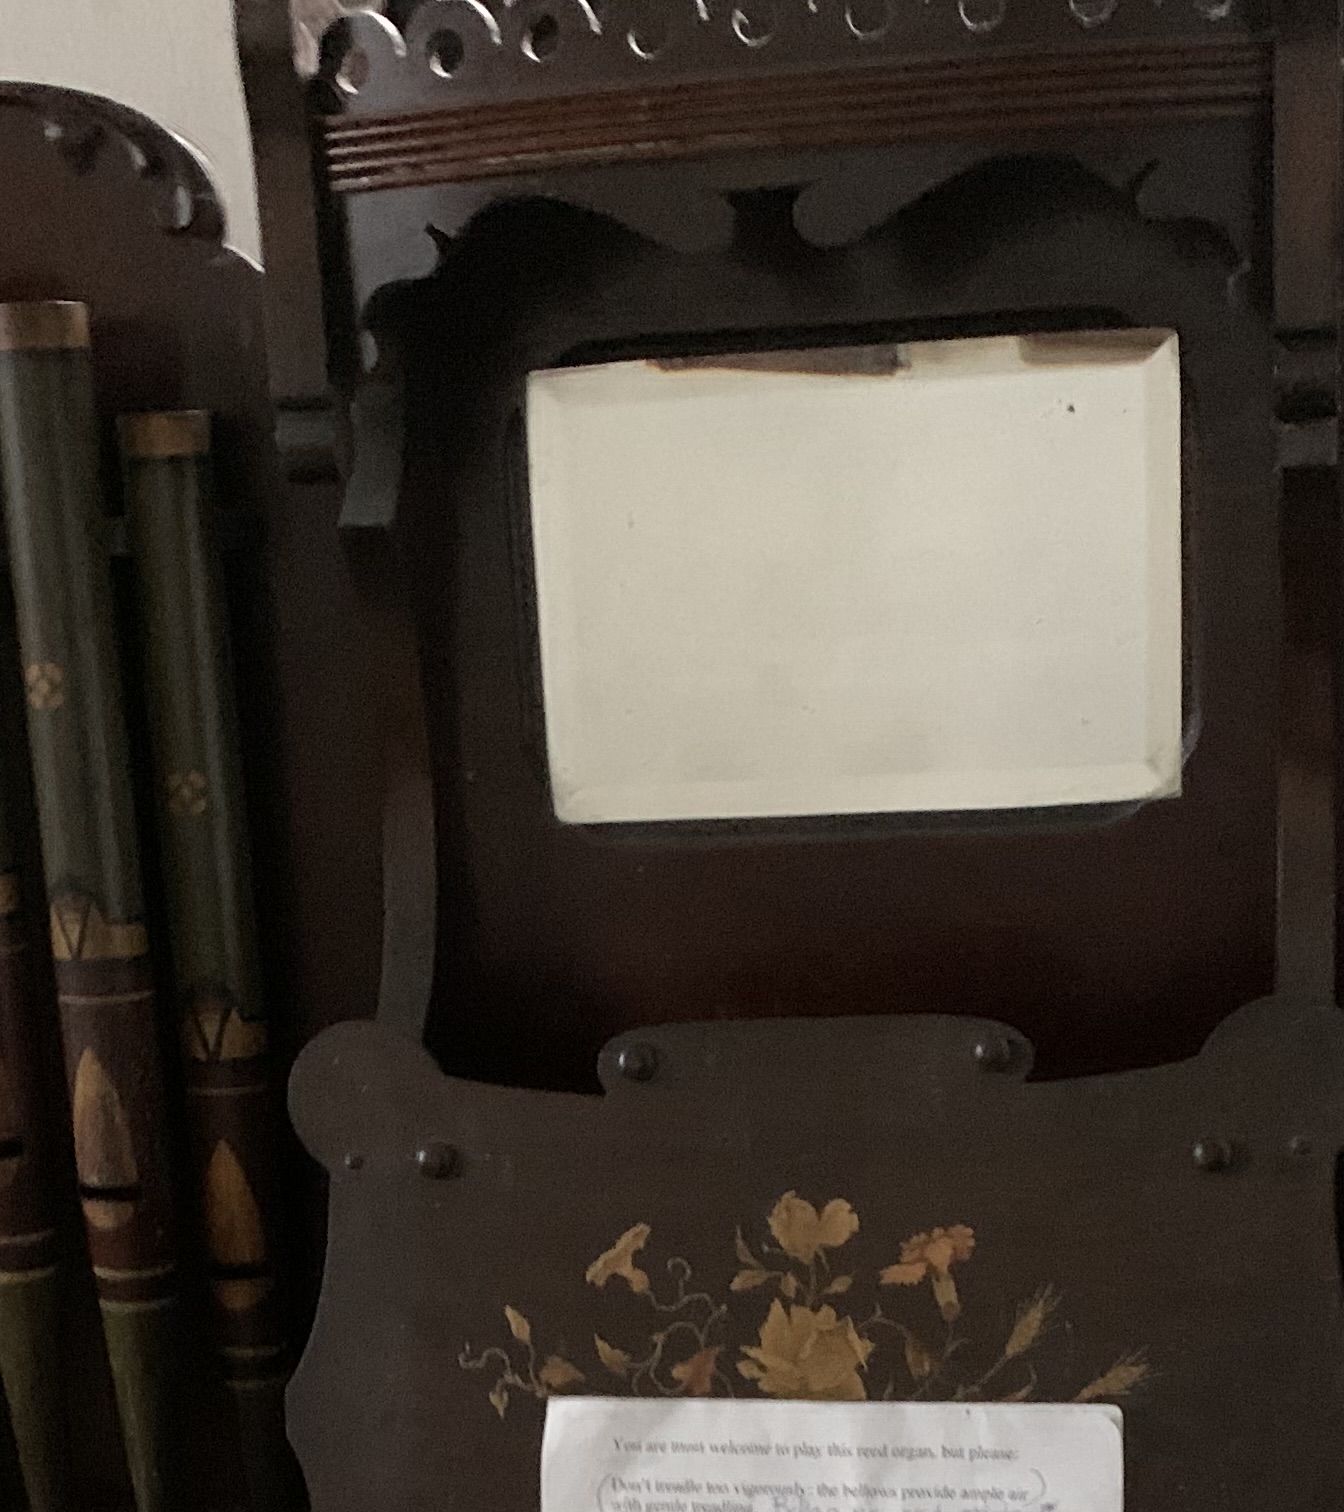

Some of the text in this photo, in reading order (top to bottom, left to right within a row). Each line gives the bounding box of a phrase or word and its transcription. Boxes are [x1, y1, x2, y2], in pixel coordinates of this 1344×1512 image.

[614, 1437, 642, 1454] You
[646, 1441, 667, 1454] are
[671, 1440, 705, 1454] most
[710, 1440, 772, 1456] welcome
[776, 1443, 790, 1457] to
[793, 1442, 822, 1460] play
[827, 1442, 853, 1458] this
[857, 1443, 888, 1459] reed
[941, 1444, 965, 1460] but
[706, 1480, 729, 1495] too
[817, 1482, 839, 1498] the
[901, 1485, 957, 1502] provide
[611, 1496, 642, 1512] with
